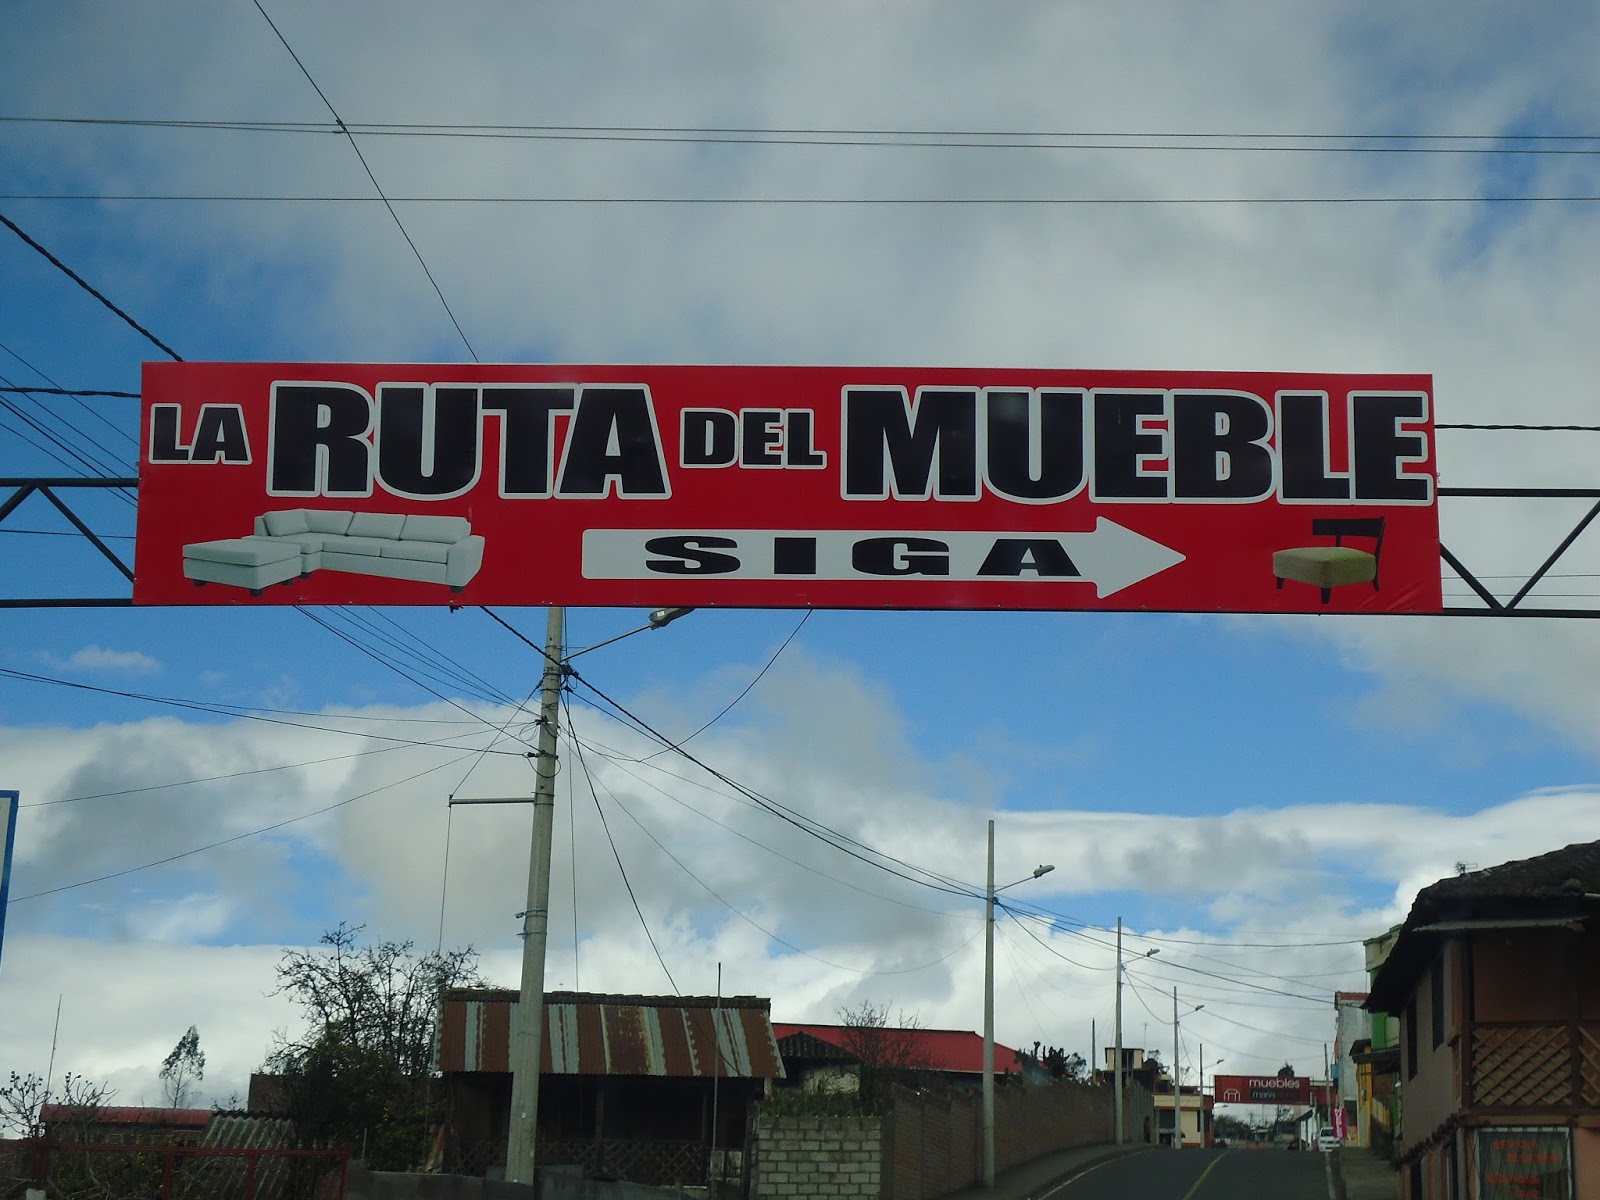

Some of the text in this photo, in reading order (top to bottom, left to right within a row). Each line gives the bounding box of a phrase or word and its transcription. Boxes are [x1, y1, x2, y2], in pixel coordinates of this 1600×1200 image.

[149, 379, 1436, 506] LA RUTA DEL MUEBLE
[644, 535, 1081, 578] SIGA
[1249, 1078, 1300, 1089] muebles
